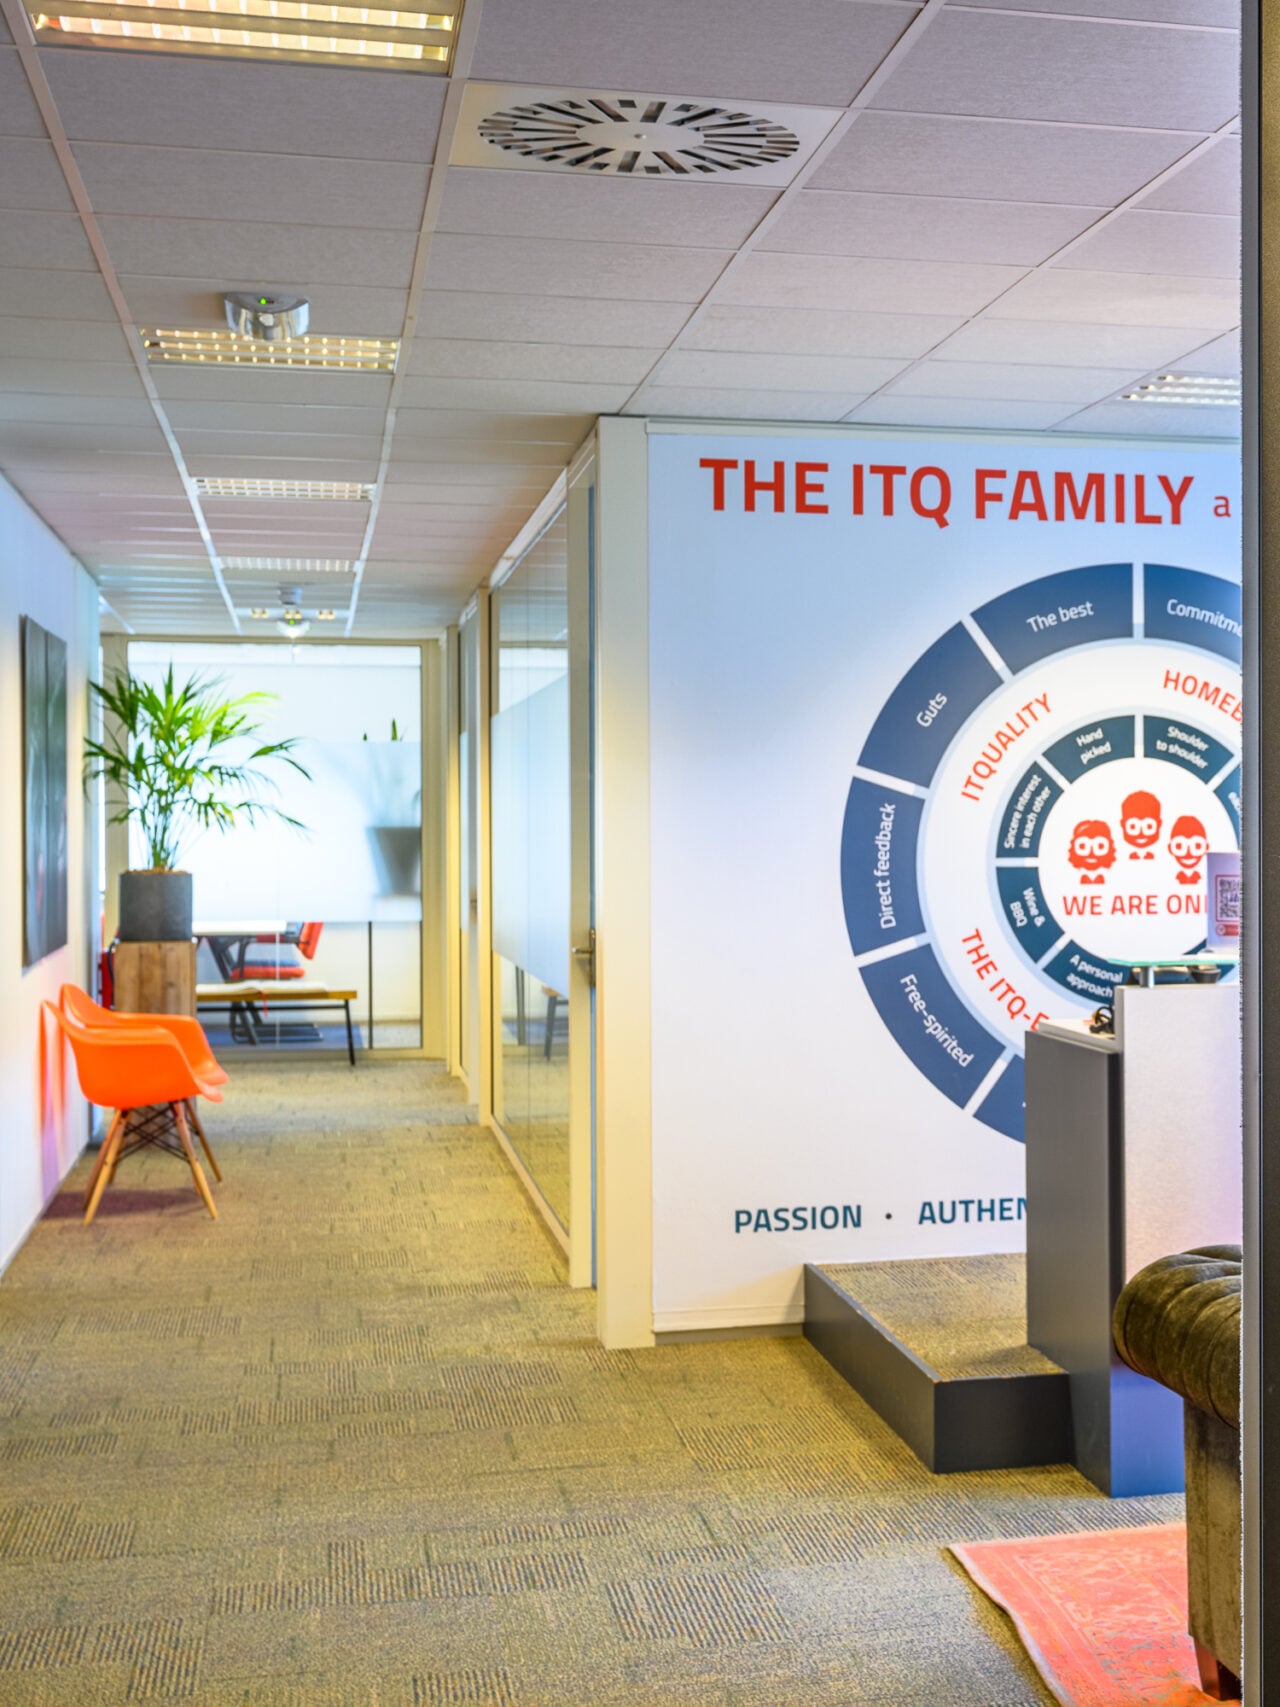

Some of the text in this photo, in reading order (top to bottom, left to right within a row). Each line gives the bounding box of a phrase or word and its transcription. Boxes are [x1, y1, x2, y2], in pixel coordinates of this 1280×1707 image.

[700, 457, 1231, 529] THE ITQ FAMILY a
[1025, 601, 1095, 633] The best
[916, 692, 948, 728] Guts
[960, 692, 1052, 801] ITQUALITY
[1076, 727, 1103, 747] Hand
[1167, 725, 1209, 752] Shoulder
[1079, 741, 1112, 765] picked
[1156, 739, 1209, 769] to shoulder
[1003, 774, 1042, 849] Sincere interest
[873, 802, 897, 930] Direct feedback
[1009, 900, 1028, 928] BBQ
[1023, 886, 1040, 917] Wine
[1062, 895, 1102, 916] WE
[1110, 894, 1159, 915] ARE
[961, 928, 998, 982] THE
[1069, 954, 1124, 984] A personal
[1066, 972, 1113, 998] approach
[900, 973, 975, 1069] Free-spirited
[734, 1204, 862, 1234] PASSION
